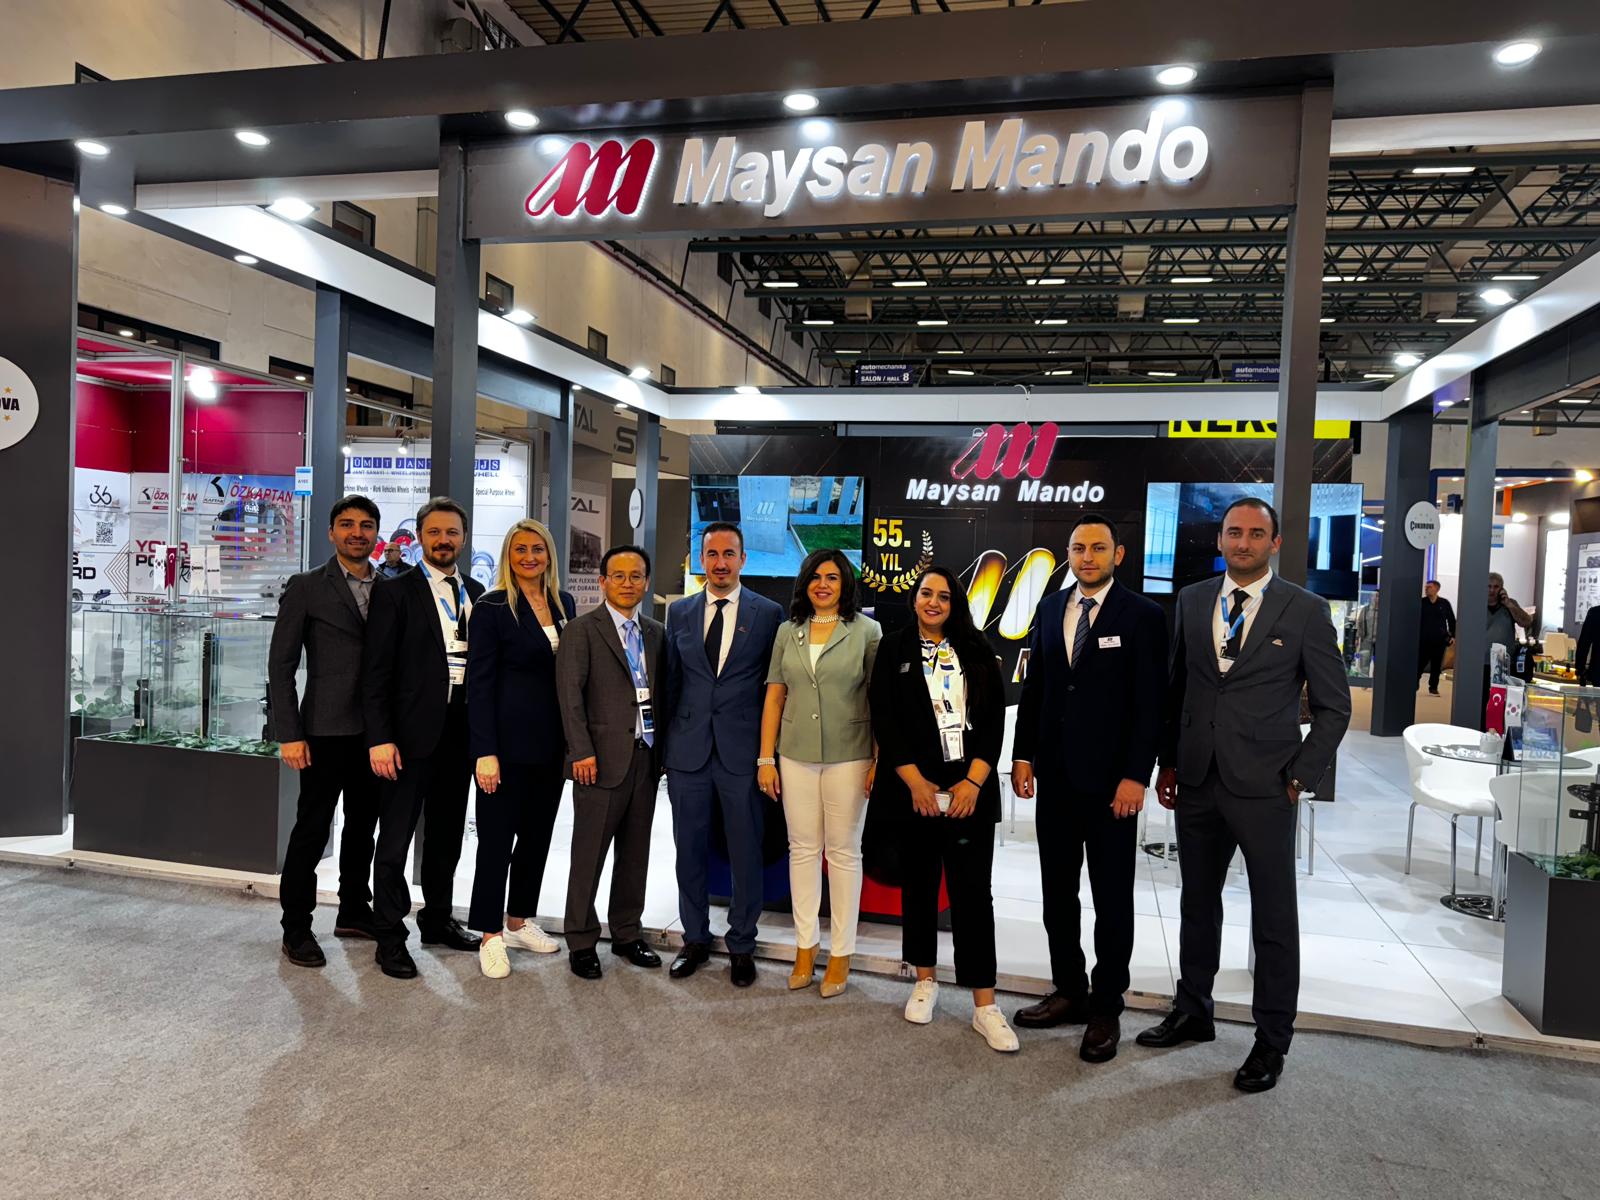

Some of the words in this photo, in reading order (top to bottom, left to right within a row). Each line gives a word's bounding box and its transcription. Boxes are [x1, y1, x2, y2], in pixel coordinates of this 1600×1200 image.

[673, 136, 934, 217] Maysan
[951, 110, 1209, 191] Mando
[903, 373, 909, 381] 8
[89, 485, 112, 505] 36
[906, 479, 1000, 505] Maysan
[1018, 480, 1104, 503] Mando
[873, 518, 911, 547] 55.
[880, 553, 902, 571] YIL
